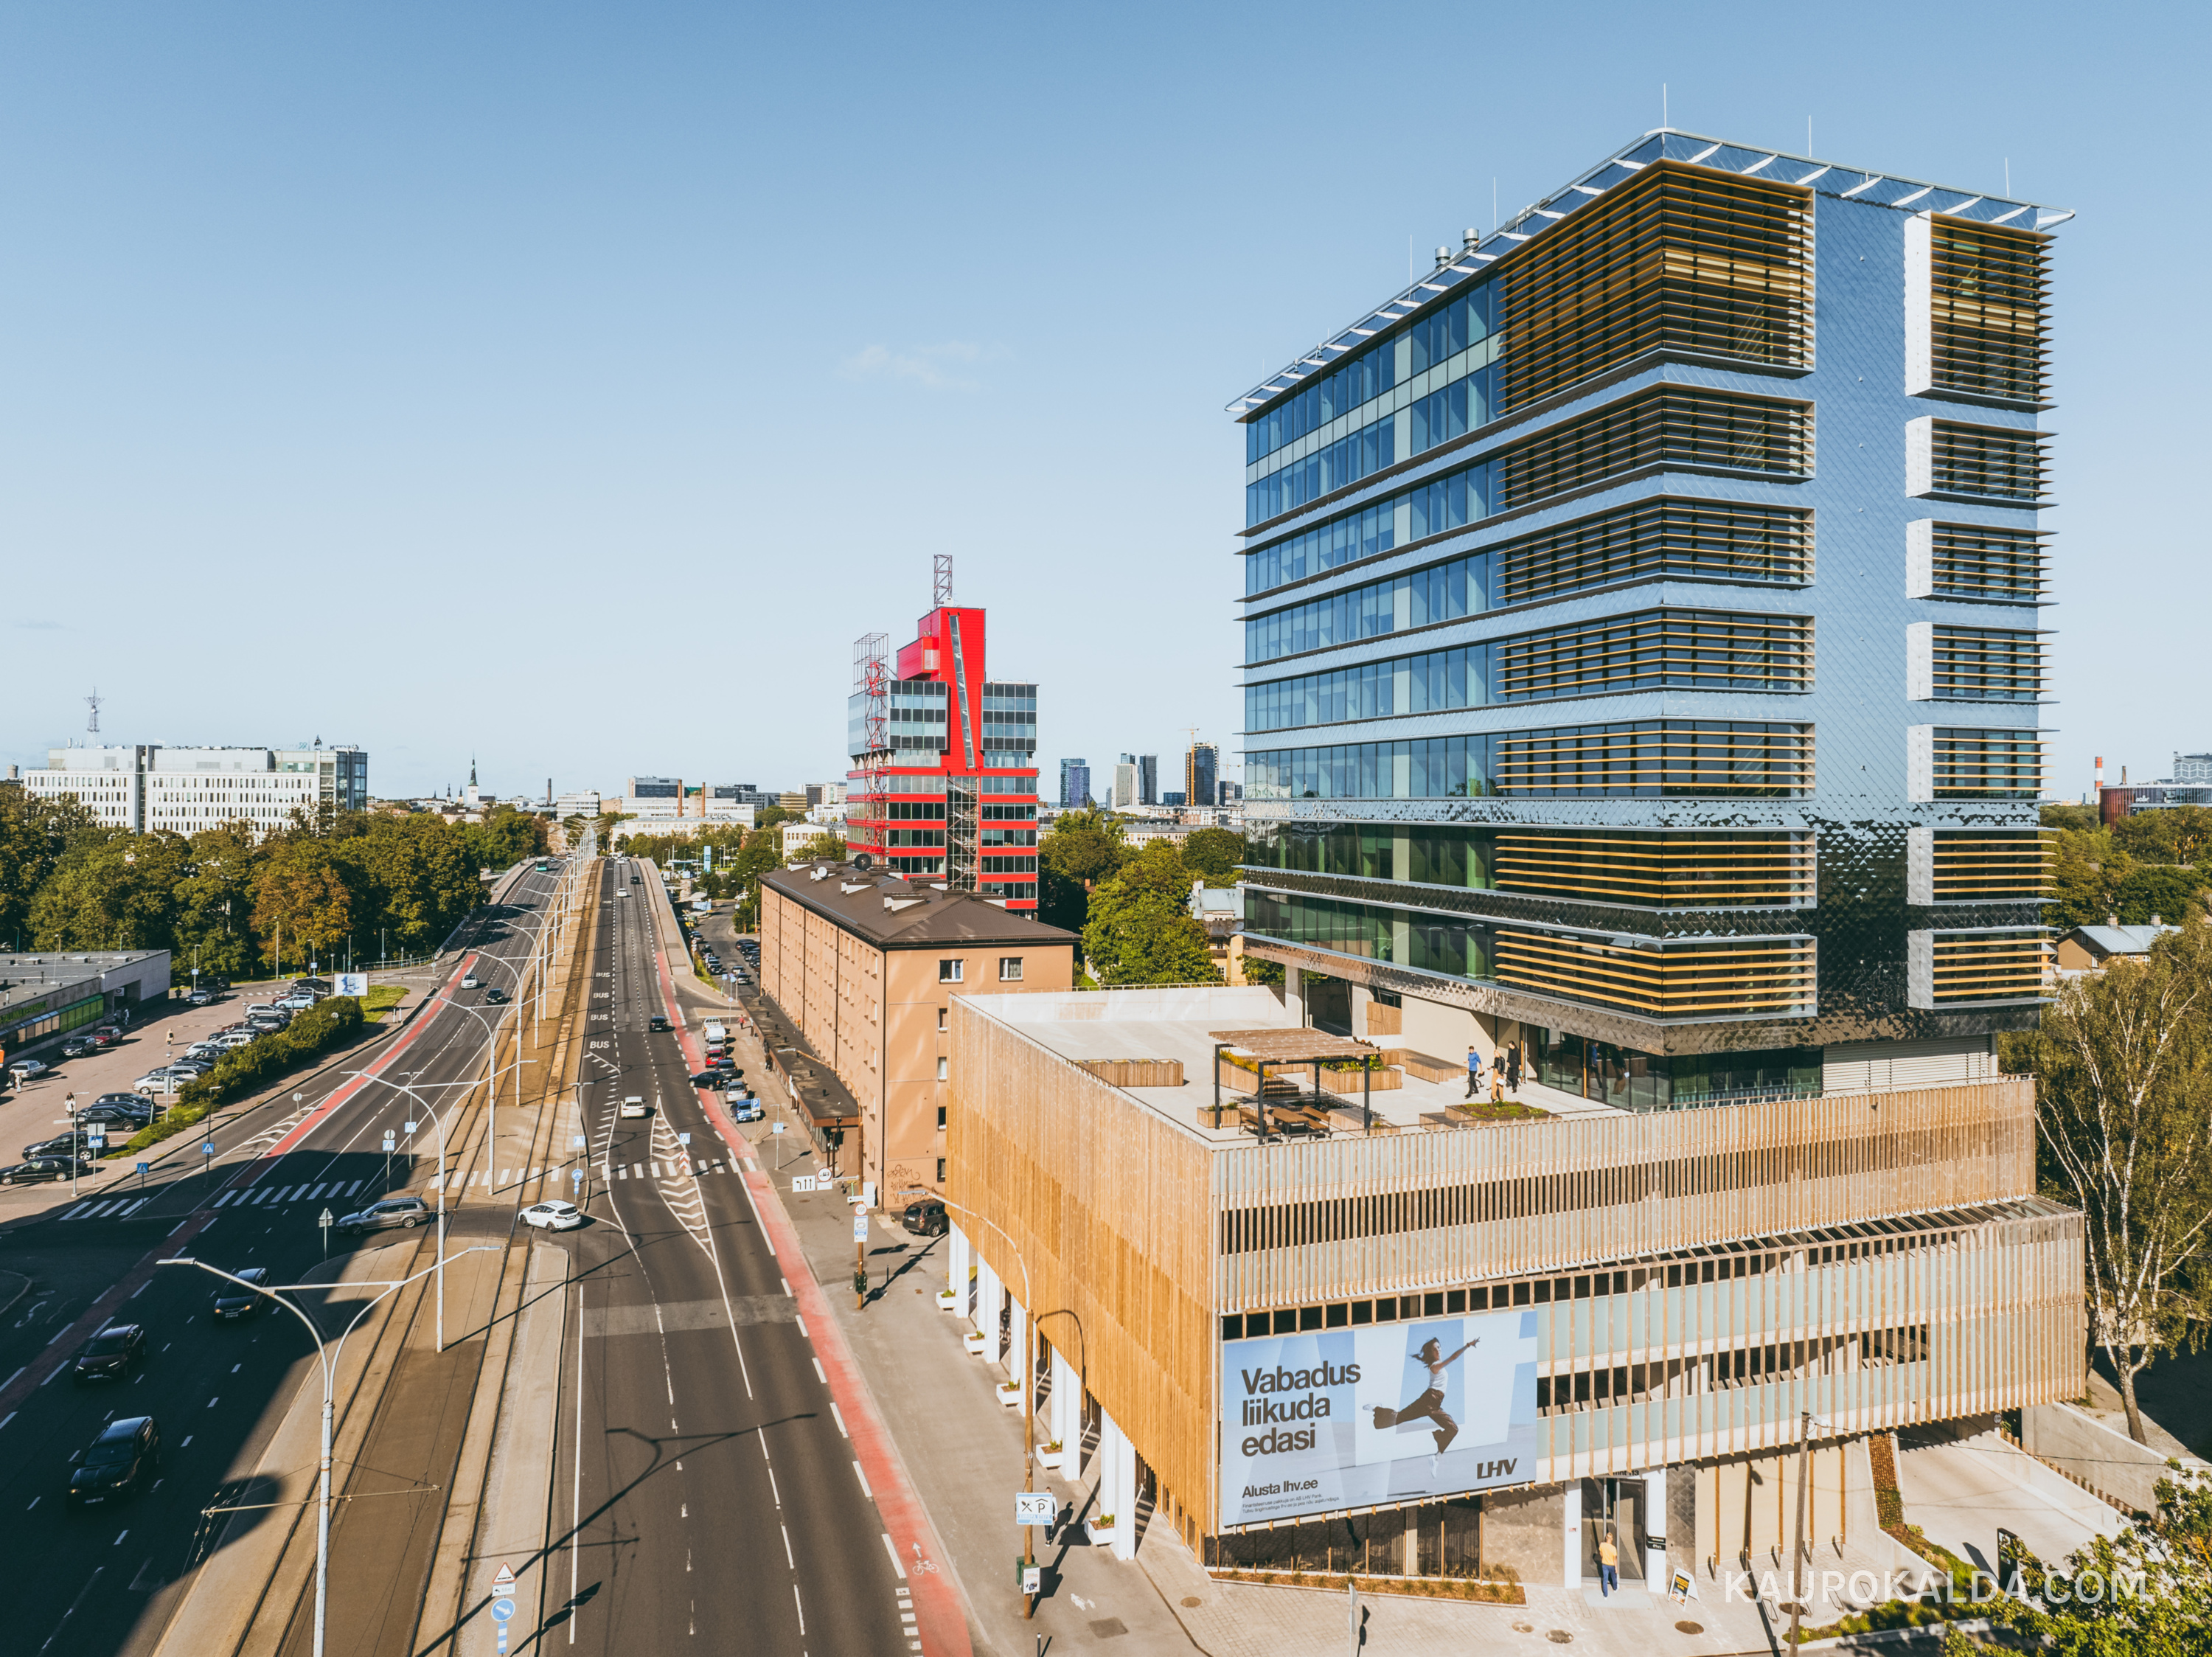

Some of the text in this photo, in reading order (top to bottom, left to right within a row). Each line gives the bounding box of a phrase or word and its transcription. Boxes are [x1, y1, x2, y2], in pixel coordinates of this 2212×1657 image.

[589, 1041, 610, 1049] BUS
[753, 1100, 759, 1108] P
[1241, 1361, 1361, 1395] Vabadus
[1242, 1392, 1331, 1427] liikuda
[1242, 1422, 1315, 1457] edasi
[1477, 1457, 1517, 1479] LHV
[1242, 1479, 1318, 1498] Alusta lhv.ee
[1038, 1503, 1046, 1513] P
